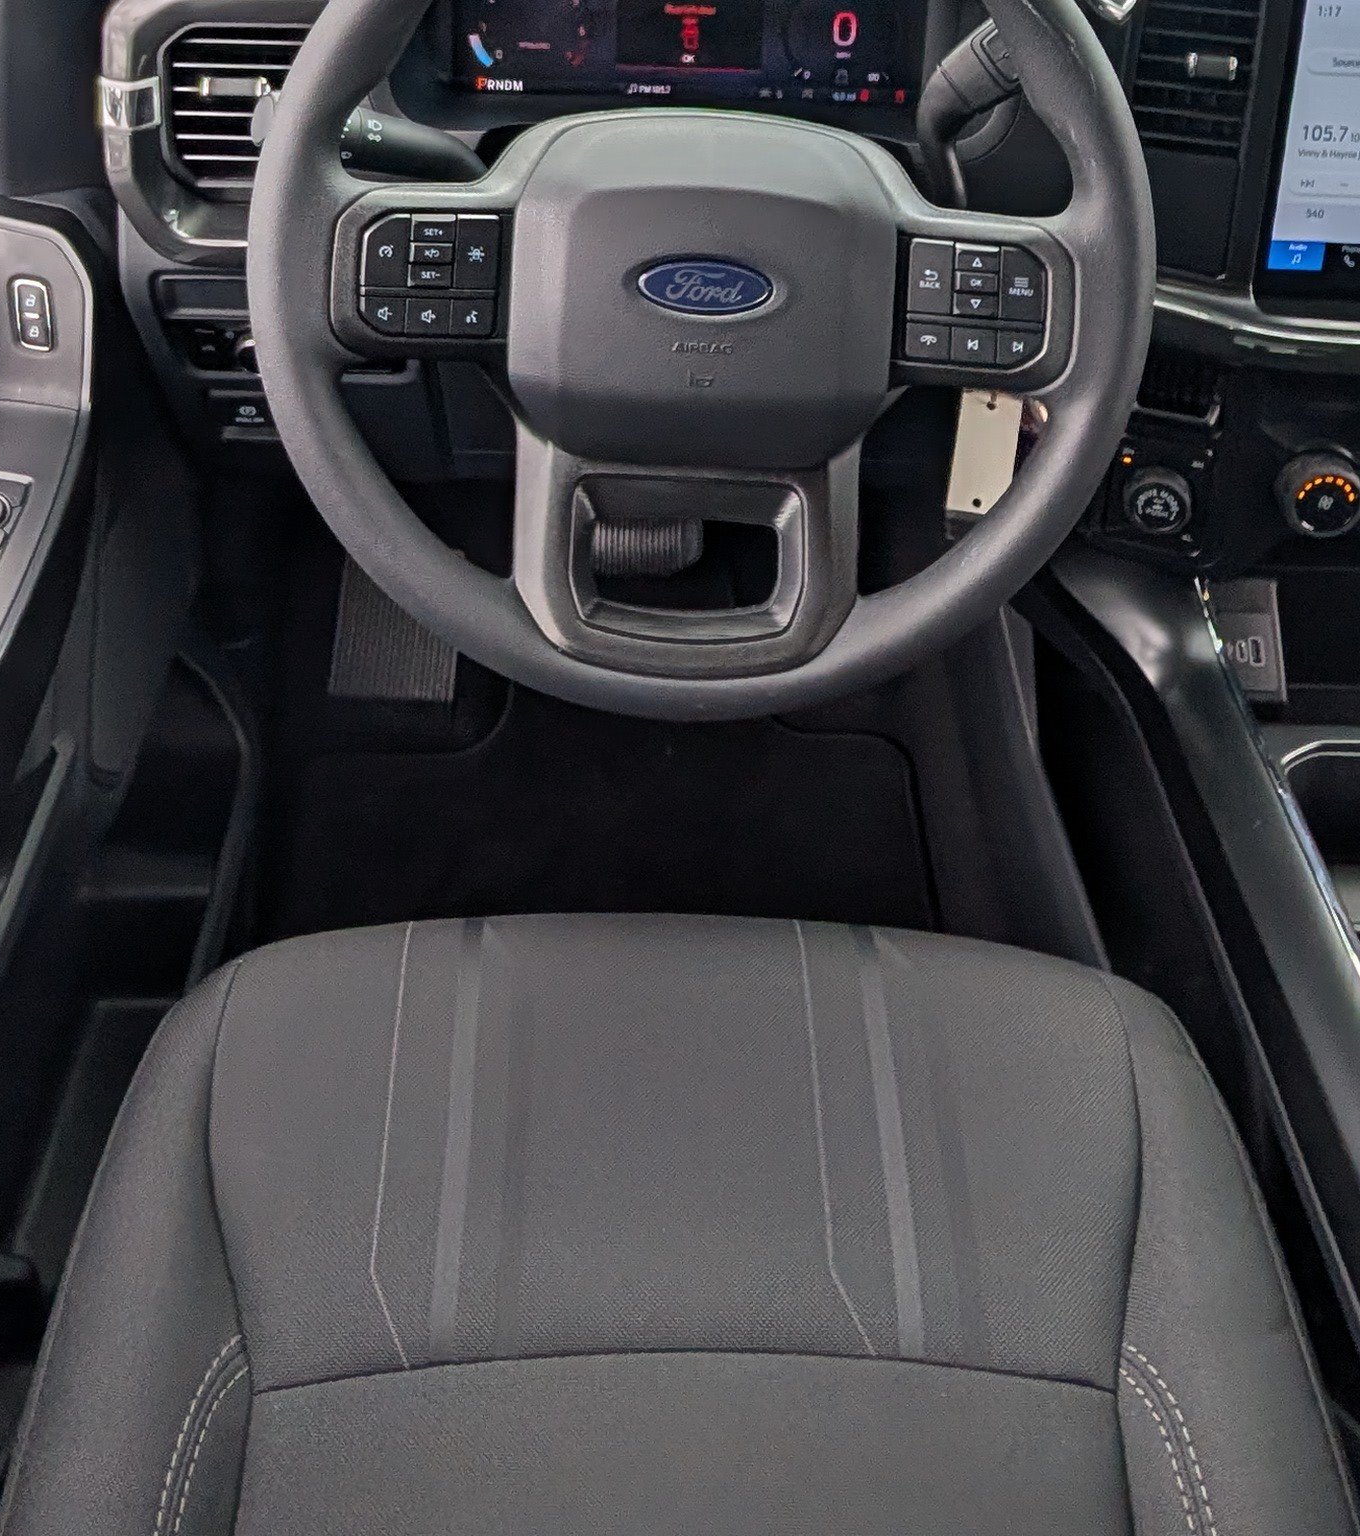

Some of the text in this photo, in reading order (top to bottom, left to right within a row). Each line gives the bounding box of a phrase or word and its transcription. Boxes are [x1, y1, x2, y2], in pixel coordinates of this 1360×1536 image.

[1317, 5, 1342, 18] 1:17
[832, 11, 858, 47] 0
[1302, 124, 1349, 142] 105.7
[665, 269, 745, 303] Ford
[919, 280, 941, 289] BACK
